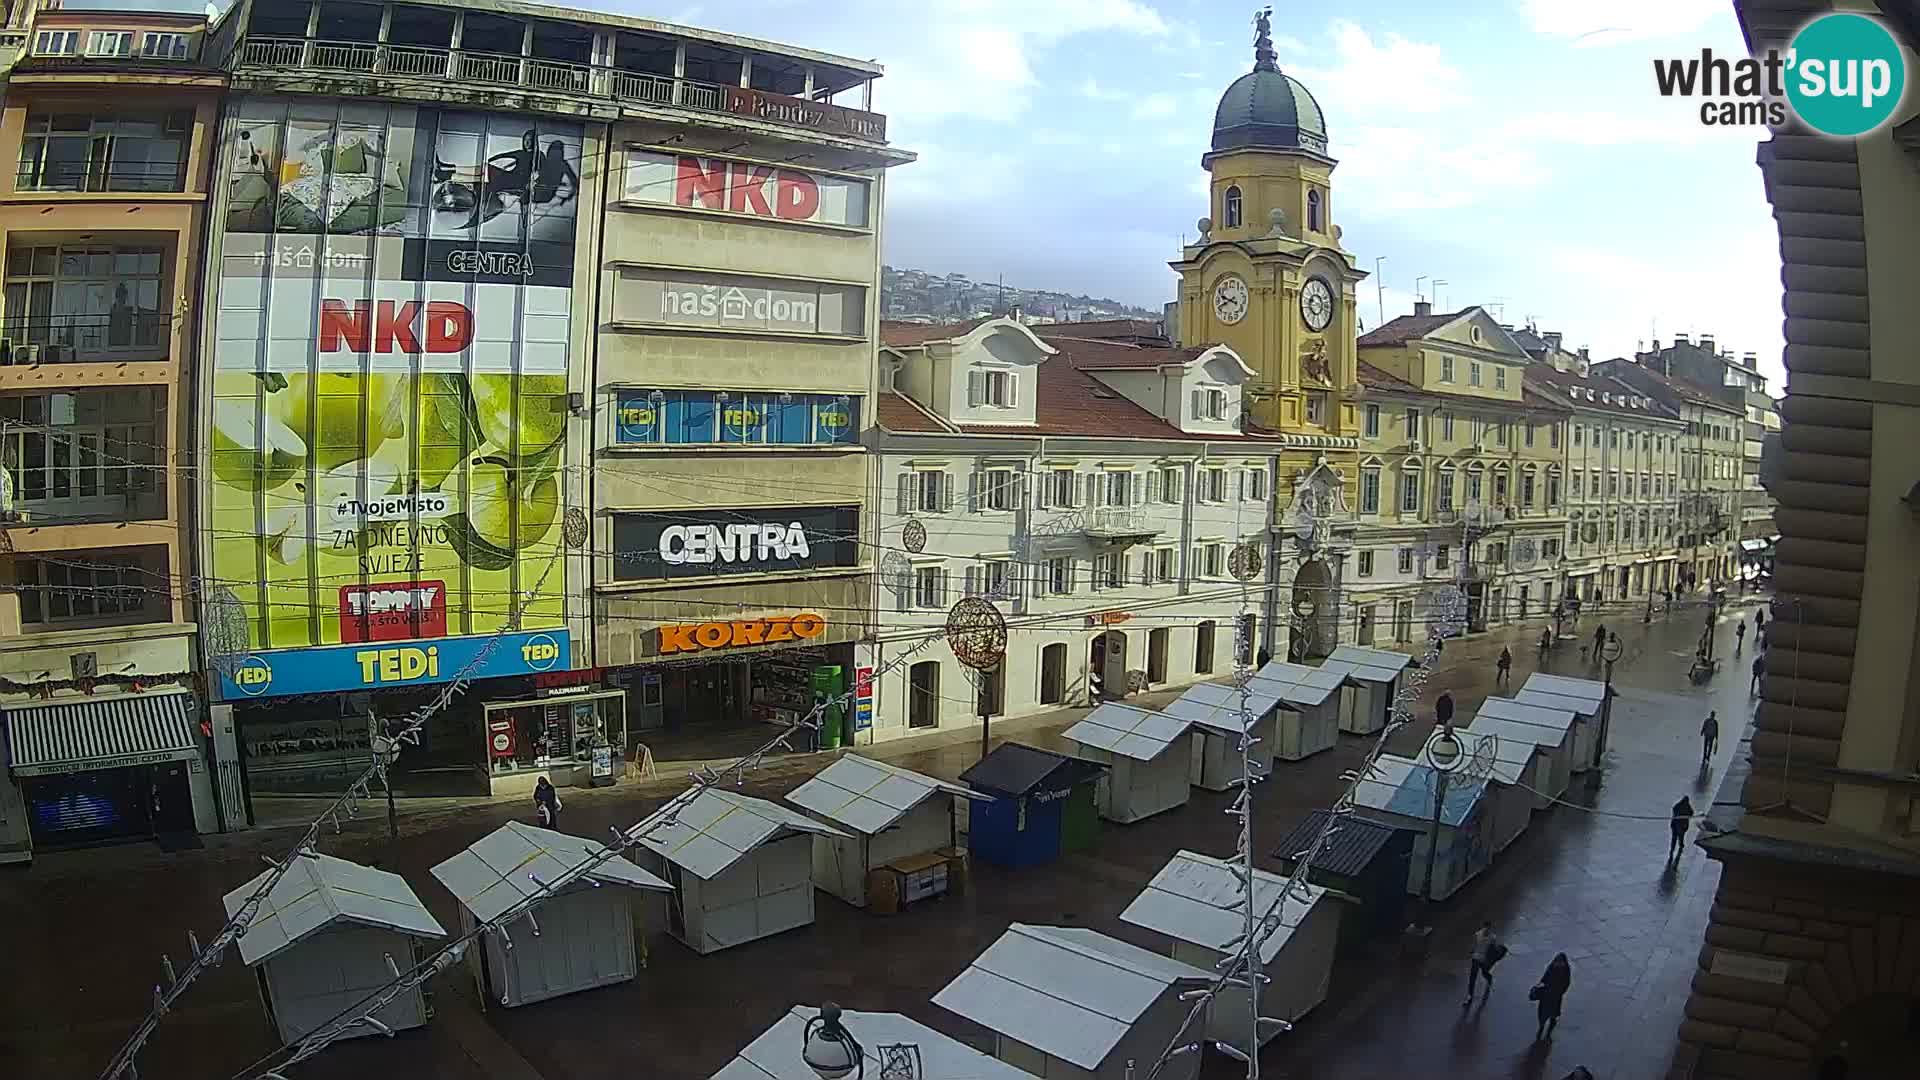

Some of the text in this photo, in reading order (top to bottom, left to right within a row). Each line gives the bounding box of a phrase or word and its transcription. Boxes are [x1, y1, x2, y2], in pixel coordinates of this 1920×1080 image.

[676, 157, 820, 220] NKD
[447, 250, 534, 276] CENTRA
[662, 284, 816, 323] naš dom
[320, 299, 475, 354] NKD
[724, 410, 759, 426] TEDi
[337, 498, 445, 517] #TvojeMisto
[333, 525, 449, 549] ZA DNEVNO
[658, 521, 810, 565] CENTRA
[359, 548, 425, 575] SVJEŽE
[347, 587, 439, 615] TOMMY
[660, 613, 825, 655] KORZO
[357, 647, 439, 683] TEDi
[522, 643, 559, 661] TEDi
[235, 666, 272, 685] TEDi
